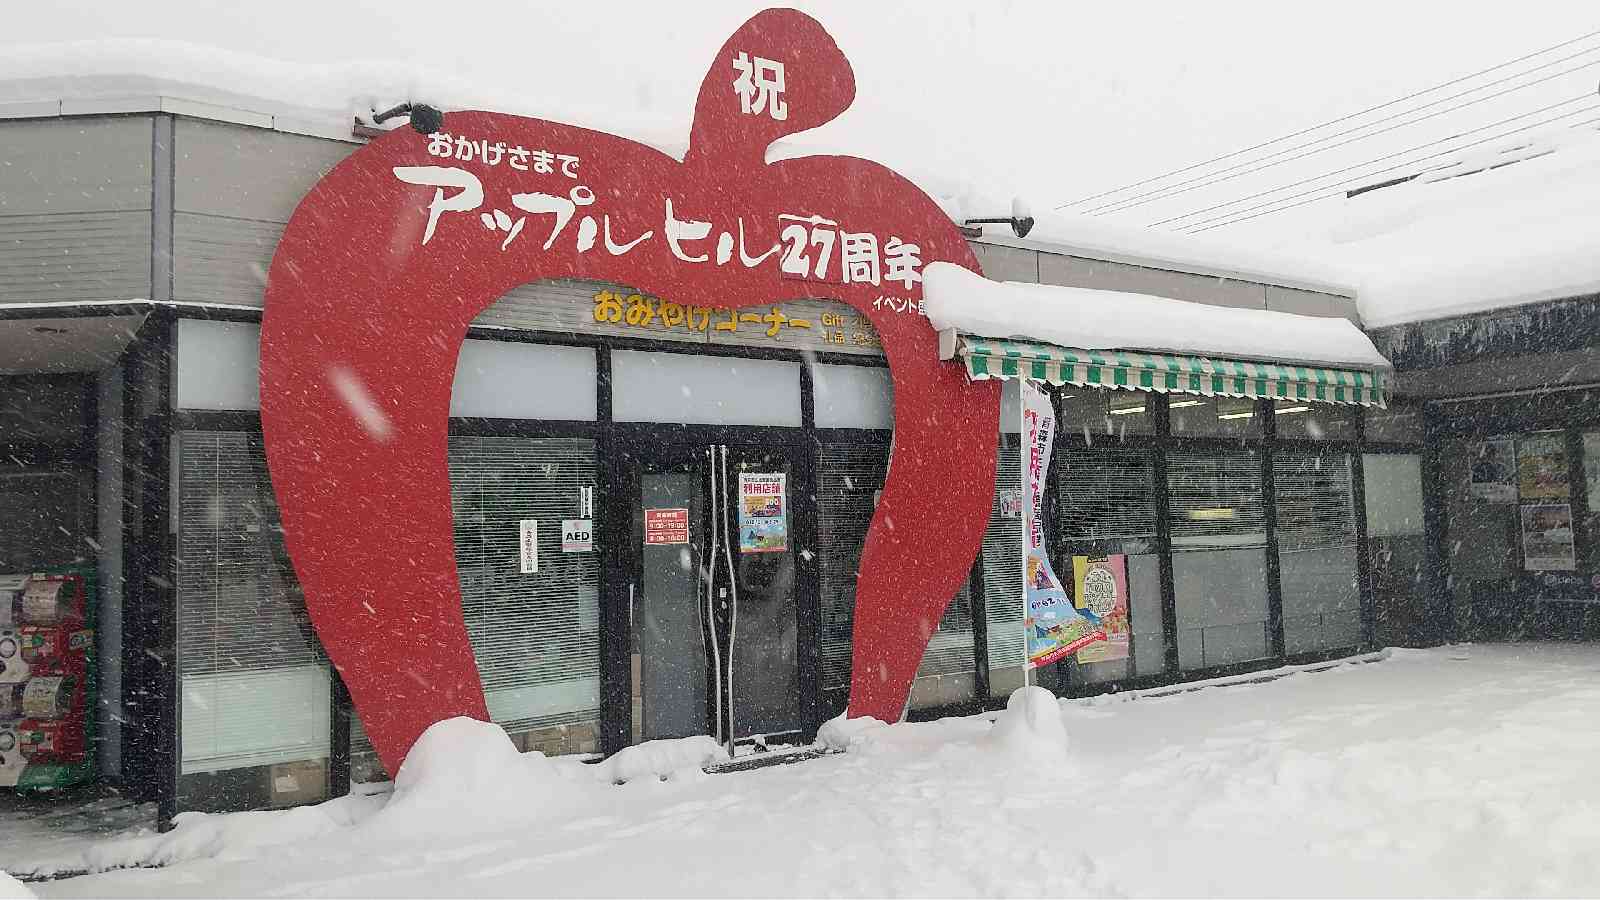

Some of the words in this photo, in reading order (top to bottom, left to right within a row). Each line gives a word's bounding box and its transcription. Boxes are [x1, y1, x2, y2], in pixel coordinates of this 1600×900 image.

[733, 52, 788, 121] 祝
[427, 131, 581, 179] おかげさまで
[821, 311, 845, 327] Gift
[743, 483, 781, 494] 利用店舗
[566, 531, 590, 541] AED
